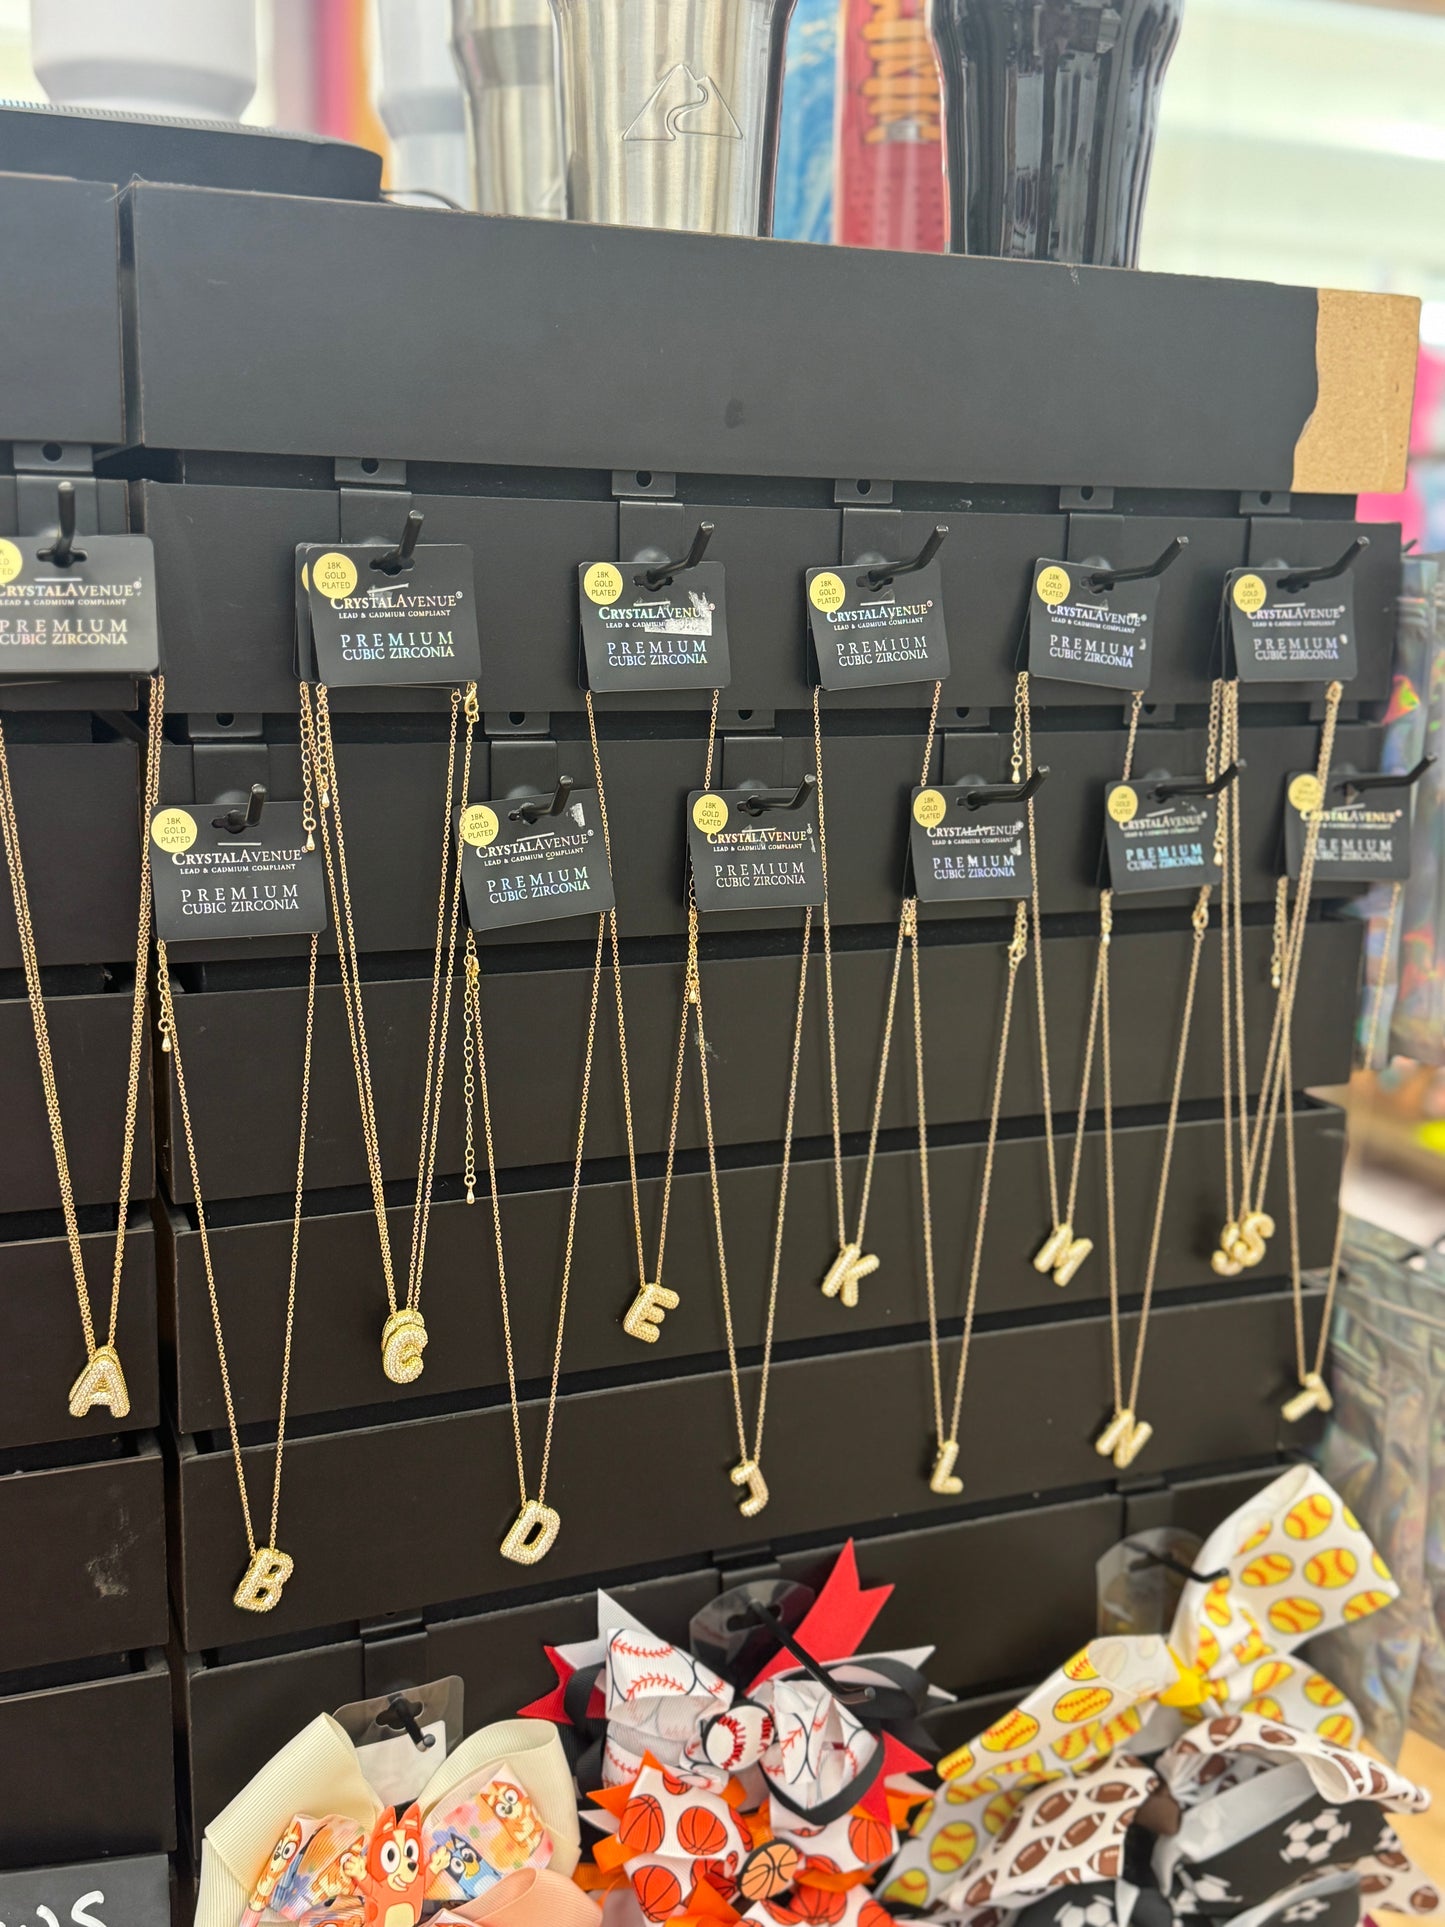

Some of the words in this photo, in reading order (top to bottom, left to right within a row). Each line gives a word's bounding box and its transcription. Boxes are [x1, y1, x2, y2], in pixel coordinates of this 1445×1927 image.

[1046, 582, 1061, 590] GOLD
[1042, 590, 1063, 598] PLATED
[0, 619, 128, 633] PREMIUM
[889, 617, 923, 625] COMPLIANT
[1074, 619, 1101, 629] CADMIUM
[1103, 624, 1135, 634] COMPLIANT
[0, 634, 46, 645] CUBIC
[52, 633, 128, 645] ZIRCONIA
[341, 631, 453, 647] PREMIUM
[836, 636, 927, 655] PREMIUM
[1050, 635, 1134, 657] PREMIUM
[1254, 638, 1338, 650] PREMIUM
[343, 648, 385, 660] CUBIC
[390, 646, 455, 658] ZIRCONIA
[608, 640, 707, 654] PREMIUM
[609, 655, 646, 666] CUBIC
[651, 654, 707, 665] ZIRCONIA
[838, 654, 872, 666] CUBIC
[876, 649, 928, 663] ZIRCONIA
[1050, 647, 1081, 660] CUBIC
[1084, 652, 1133, 668] ZIRCONIA
[1255, 650, 1287, 661] CUBIC
[1290, 649, 1339, 660] ZIRCONIA
[702, 810, 719, 818] GOLD
[470, 822, 489, 830] GOLD
[468, 830, 493, 839] PLATED
[511, 853, 543, 863] CADMIUM
[546, 847, 584, 857] COMPLIANT
[1126, 843, 1202, 860] PREMIUM
[715, 862, 804, 876] PREMIUM
[933, 855, 1014, 869] PREMIUM
[487, 867, 588, 892] PREMIUM
[934, 869, 965, 879] CUBIC
[968, 867, 1016, 878] ZIRCONIA
[716, 878, 750, 887] CUBIC
[754, 875, 806, 886] ZIRCONIA
[181, 885, 298, 902] PREMIUM
[490, 890, 528, 903] CUBIC
[532, 880, 590, 897] ZIRCONIA
[182, 902, 226, 914] CUBIC
[232, 899, 299, 913] ZIRCONIA
[1034, 1223, 1092, 1285] M
[822, 1243, 880, 1305] K
[623, 1283, 680, 1341] E
[69, 1346, 130, 1417] A
[1095, 1408, 1152, 1468] N
[930, 1440, 963, 1493] L
[730, 1460, 769, 1516] J
[500, 1500, 561, 1565] D
[233, 1547, 294, 1611] B
